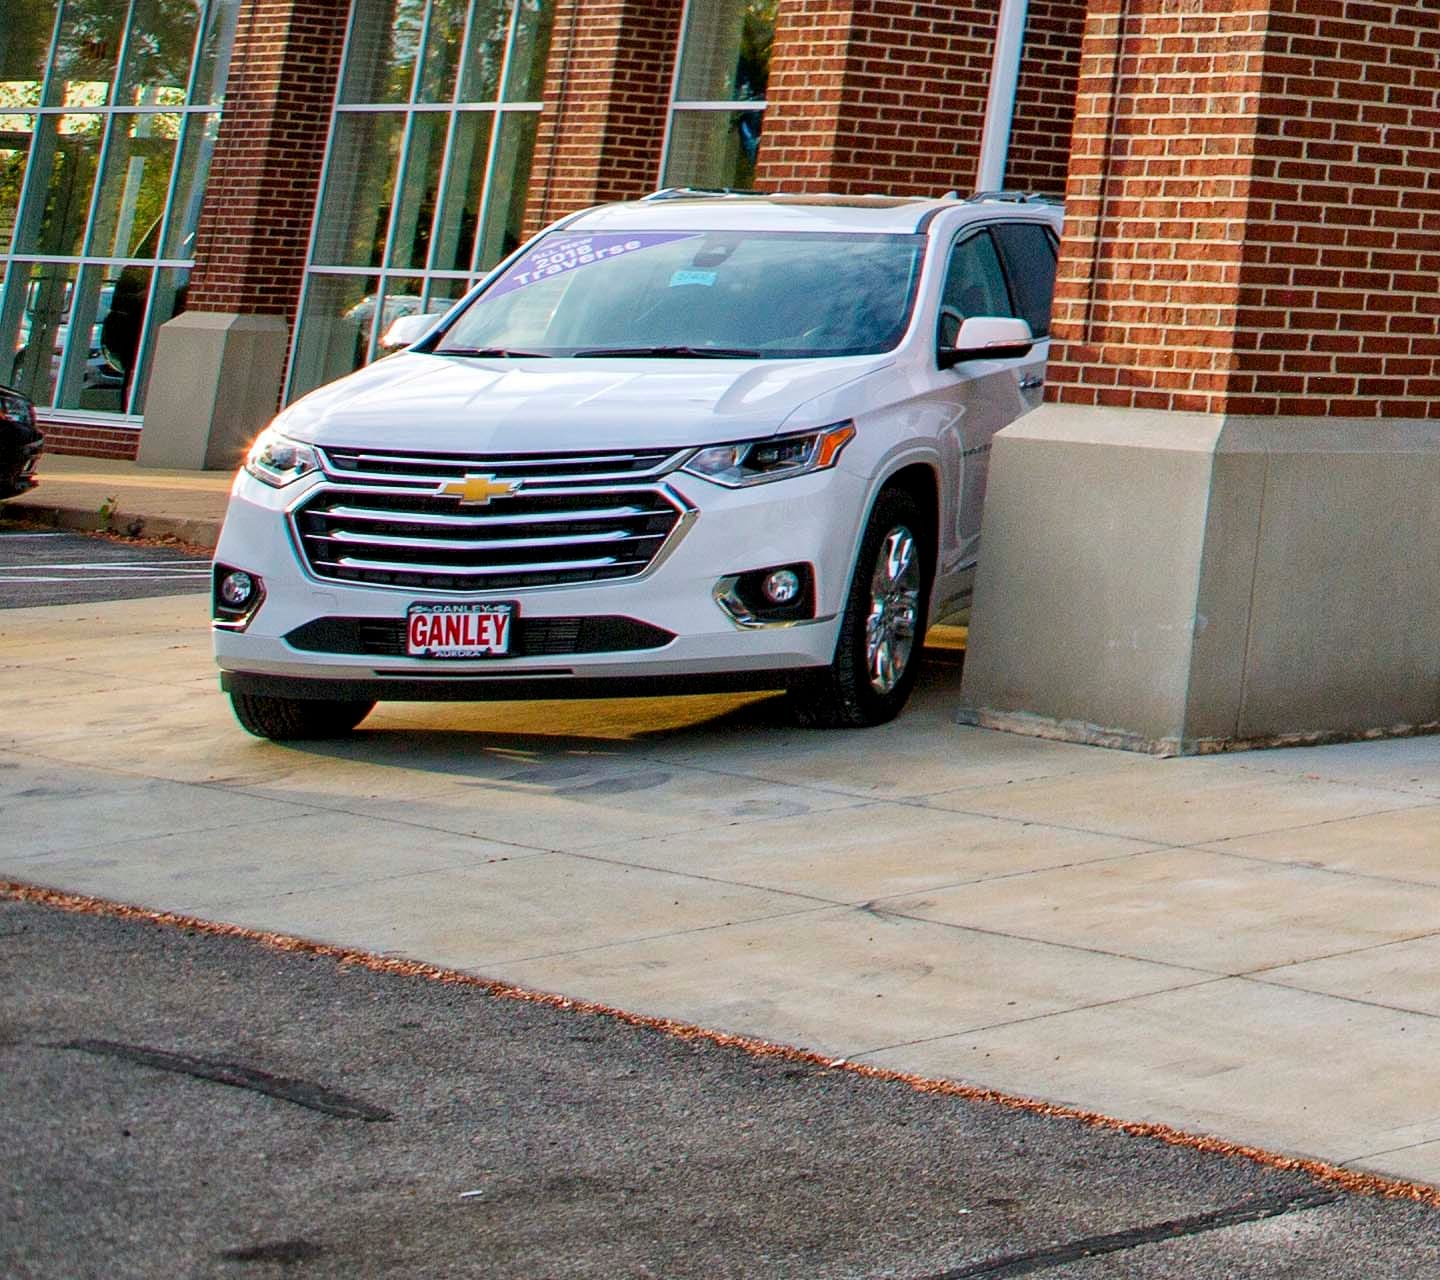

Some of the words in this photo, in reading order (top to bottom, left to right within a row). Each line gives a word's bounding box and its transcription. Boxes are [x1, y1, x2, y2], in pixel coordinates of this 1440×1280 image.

[531, 248, 555, 261] ALL
[560, 237, 593, 251] NEW
[535, 244, 593, 271] 2018
[513, 240, 641, 285] Traverse
[433, 604, 490, 612] GANLEY
[411, 614, 508, 648] GANLEY
[436, 649, 482, 657] AURORA
